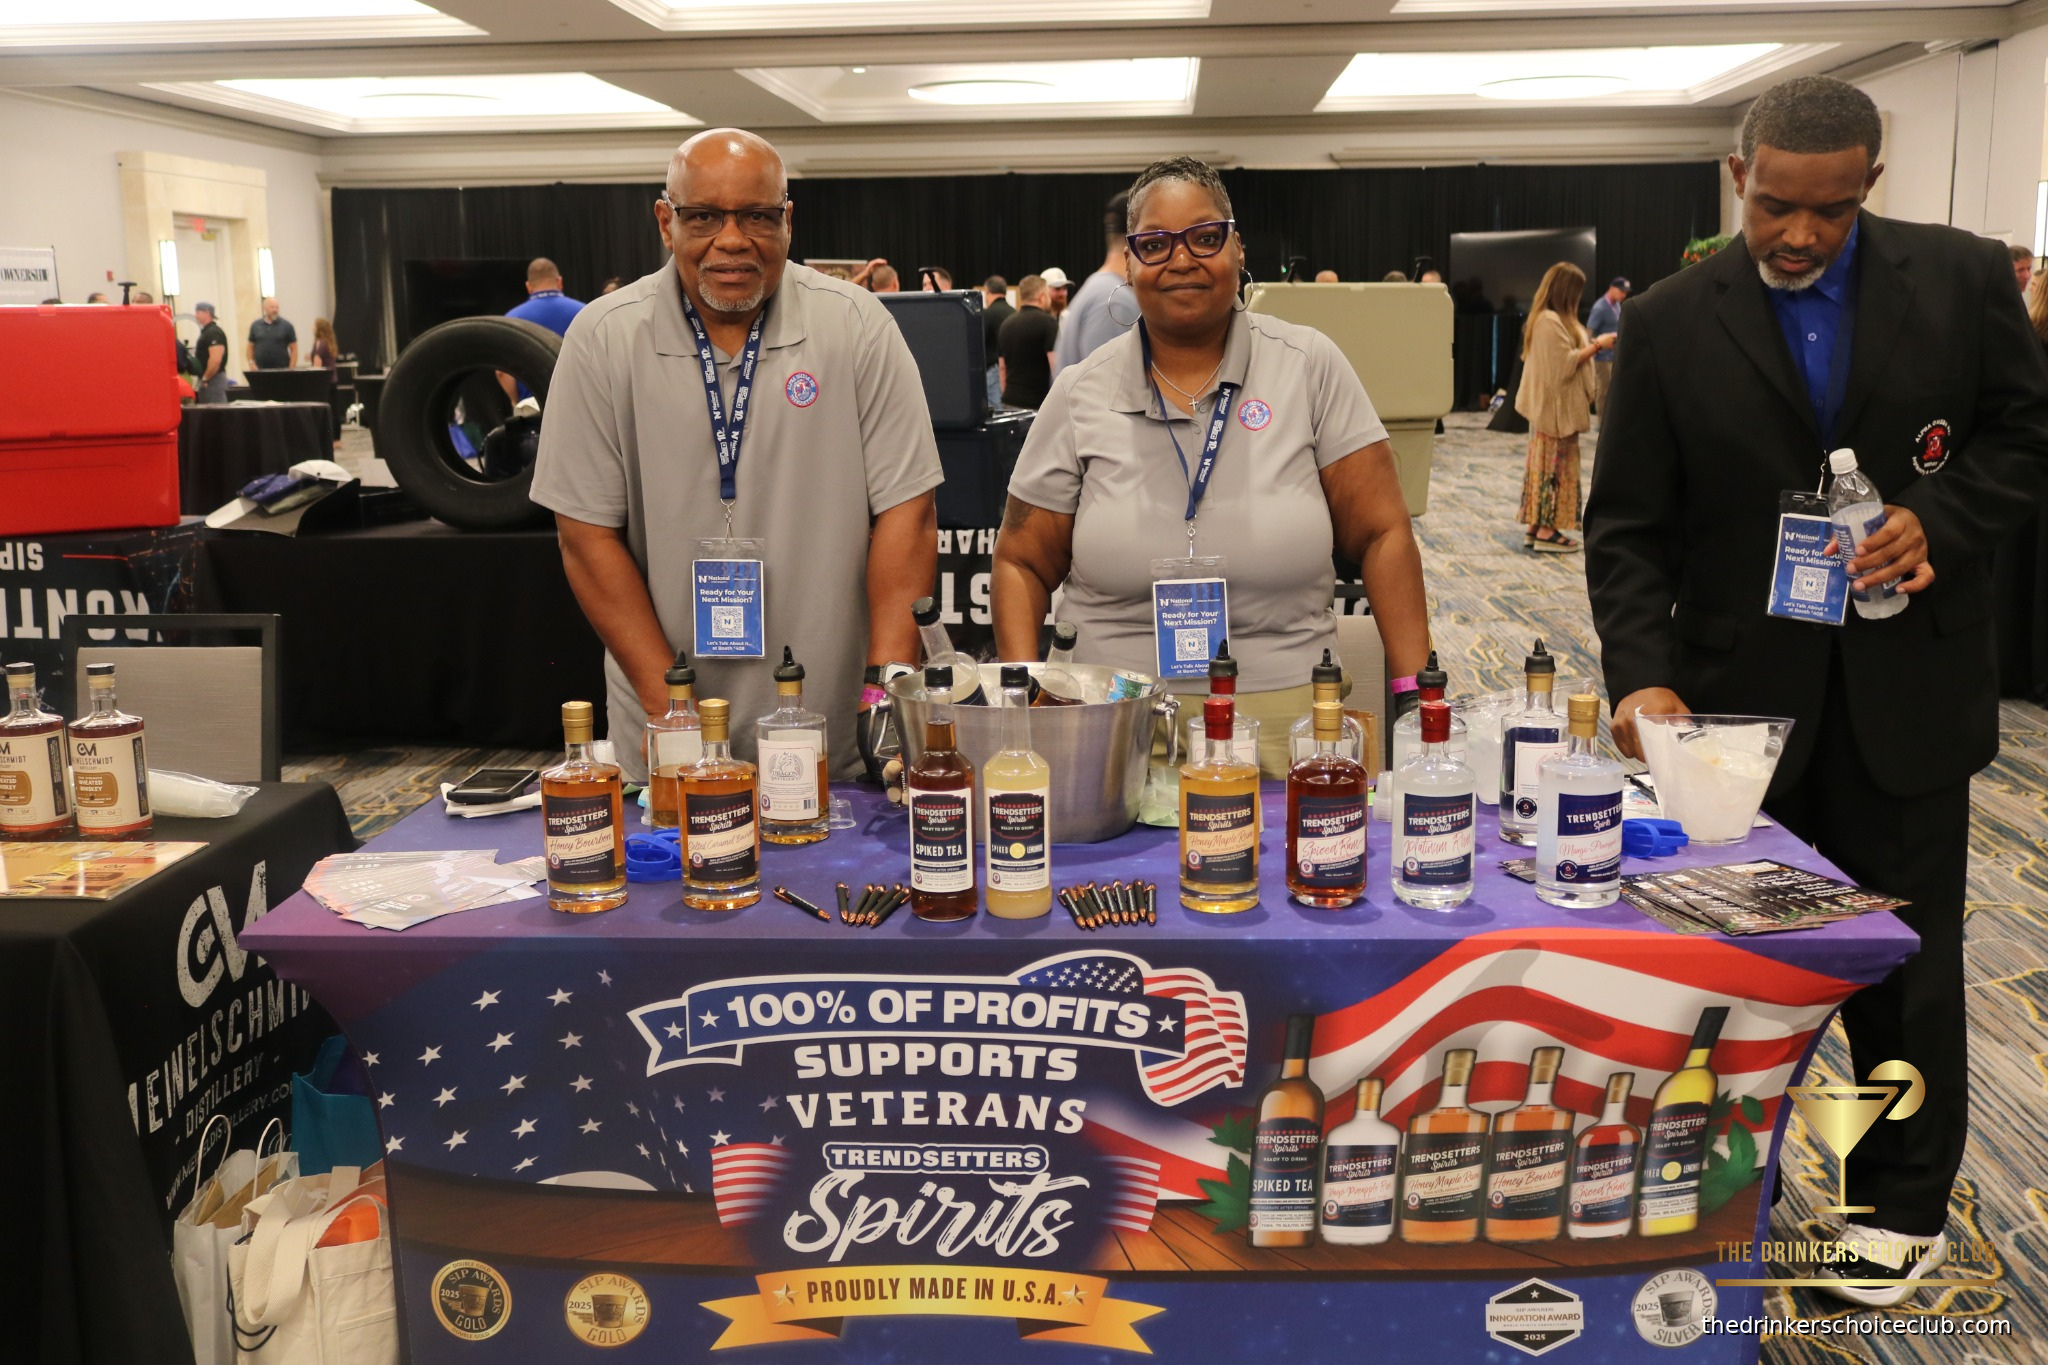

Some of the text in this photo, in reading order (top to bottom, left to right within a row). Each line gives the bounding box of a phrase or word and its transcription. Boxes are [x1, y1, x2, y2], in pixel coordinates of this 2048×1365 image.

[1785, 546, 1810, 556] Ready
[1811, 549, 1823, 557] for
[1785, 554, 1841, 568] Next Mission?
[700, 589, 723, 597] Ready
[1184, 618, 1217, 626] Mission?
[548, 808, 608, 826] TRENDSETTERS
[691, 804, 750, 825] TRENDSETTERS
[914, 807, 964, 816] TRENDSETTERS
[992, 806, 1042, 815] TRENDSETTERS
[1189, 807, 1251, 821] TRENDSETTERS
[1302, 809, 1362, 828] TRENDSETTERS
[1408, 808, 1470, 826] TRENDSETTERS
[1207, 820, 1233, 832] Spirits
[550, 838, 574, 852] Honey
[575, 832, 612, 850] Bourbon
[1189, 834, 1213, 848] Honey
[1213, 833, 1237, 847] Maple
[1302, 841, 1338, 859] Spiced
[1338, 836, 1364, 856] Rum
[915, 843, 962, 857] SPIKED TEA
[991, 844, 1009, 854] SPIKED
[727, 989, 1150, 1038] 100% OF PROFITS
[794, 1042, 1079, 1081] SUPPORTS
[186, 1051, 264, 1139] DISTILLERY
[786, 1091, 1087, 1135] VETERANS
[1254, 1136, 1319, 1144] TRENDSETTERS
[1664, 1128, 1689, 1140] Spirits
[1272, 1144, 1299, 1155] Spirits
[1411, 1145, 1481, 1164] TRENDSETTERS
[1495, 1142, 1565, 1162] TRENDSETTERS
[830, 1148, 1042, 1169] TRENDSETTERS
[1329, 1157, 1392, 1173] TRENDSETTERS
[1431, 1158, 1458, 1172] Spirits
[1515, 1156, 1542, 1170] Spirits
[1576, 1156, 1632, 1174] TRENDSETTERS
[1252, 1179, 1313, 1192] SPIKED TEA
[1409, 1177, 1435, 1191] Honey
[1435, 1173, 1462, 1189] Maple
[1493, 1175, 1524, 1190] Honey
[1525, 1167, 1564, 1185] Bourbon
[1574, 1183, 1605, 1200] Spiced
[783, 1171, 1091, 1262] Spirits
[452, 1261, 491, 1273] DOUBLE GOLD
[440, 1288, 460, 1299] 2025
[448, 1269, 503, 1315] SIP AWARDS
[579, 1275, 647, 1325] SIP AWARDS
[807, 1277, 1064, 1307] PROUDLY MADE IN U.S.A.
[1645, 1272, 1713, 1317] SIP AWARDS
[568, 1300, 592, 1310] 2025
[1635, 1301, 1660, 1312] 2025
[455, 1314, 487, 1331] GOLD
[1489, 1313, 1581, 1322] INNOVATION AWARD
[451, 1327, 490, 1339] DOUBLE GOLD
[586, 1327, 627, 1344] GOLD
[1523, 1333, 1546, 1341] 2025
[1653, 1323, 1702, 1345] SILVER
